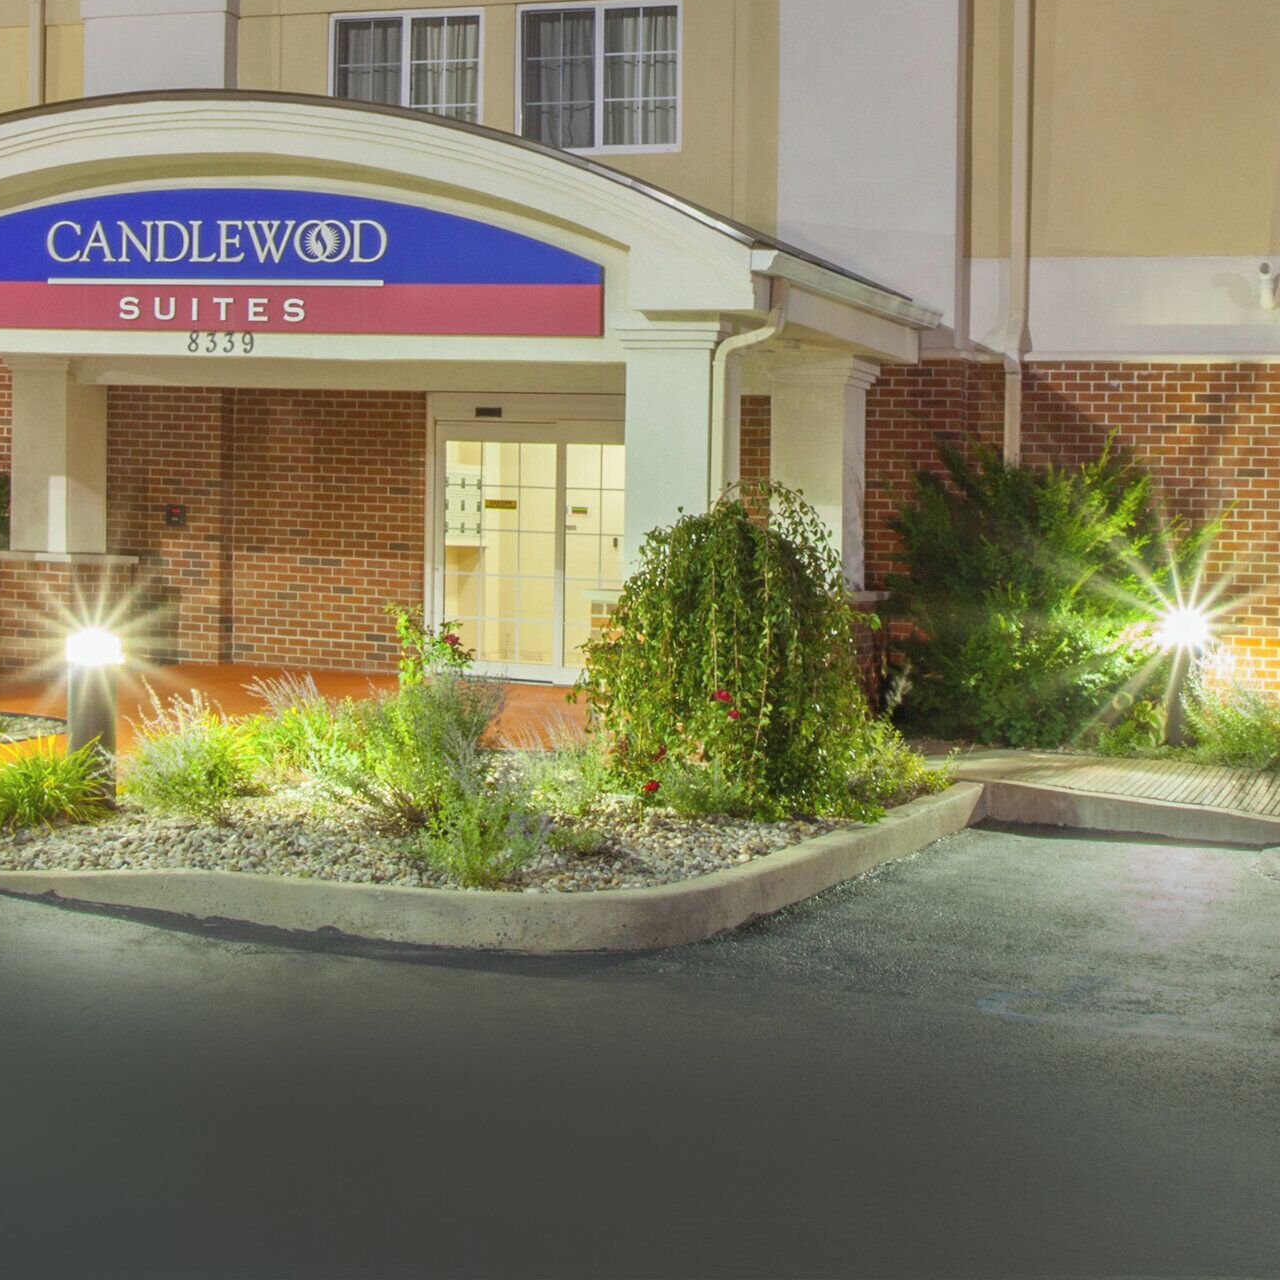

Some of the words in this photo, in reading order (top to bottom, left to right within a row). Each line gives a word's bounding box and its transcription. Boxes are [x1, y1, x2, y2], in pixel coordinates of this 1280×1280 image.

[46, 219, 387, 263] CANDLEWOOD
[119, 296, 306, 322] SUITES
[187, 331, 255, 354] 8339
